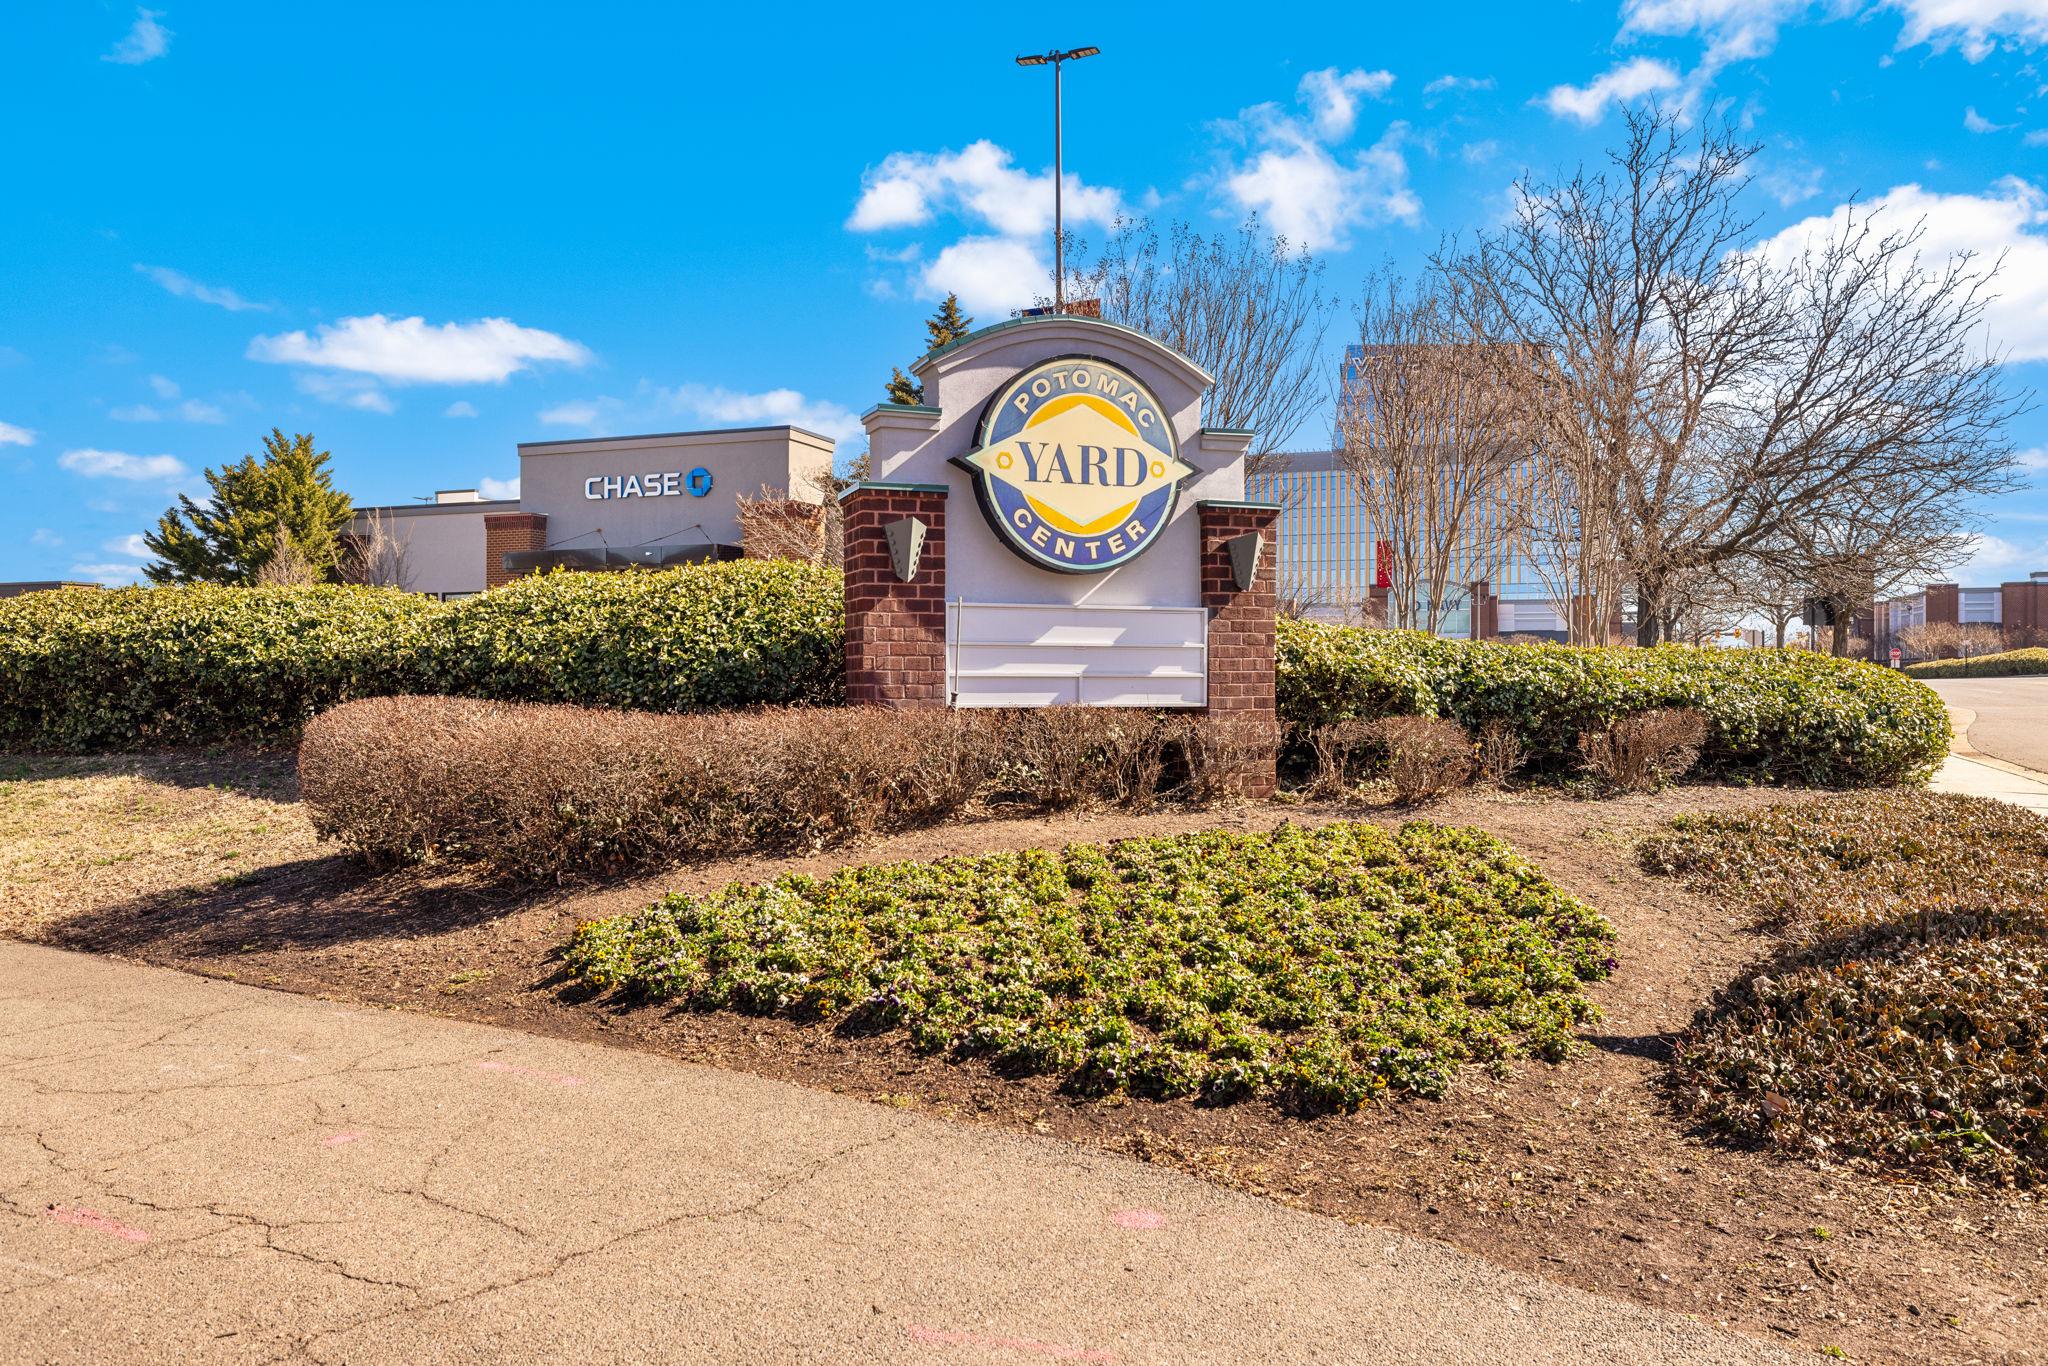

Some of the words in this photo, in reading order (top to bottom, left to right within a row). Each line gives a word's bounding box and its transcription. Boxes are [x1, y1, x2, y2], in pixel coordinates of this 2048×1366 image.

[1014, 369, 1155, 428] POTOMAC
[584, 472, 682, 500] CHASE
[1015, 441, 1148, 488] YARD
[1013, 508, 1147, 560] CENTER
